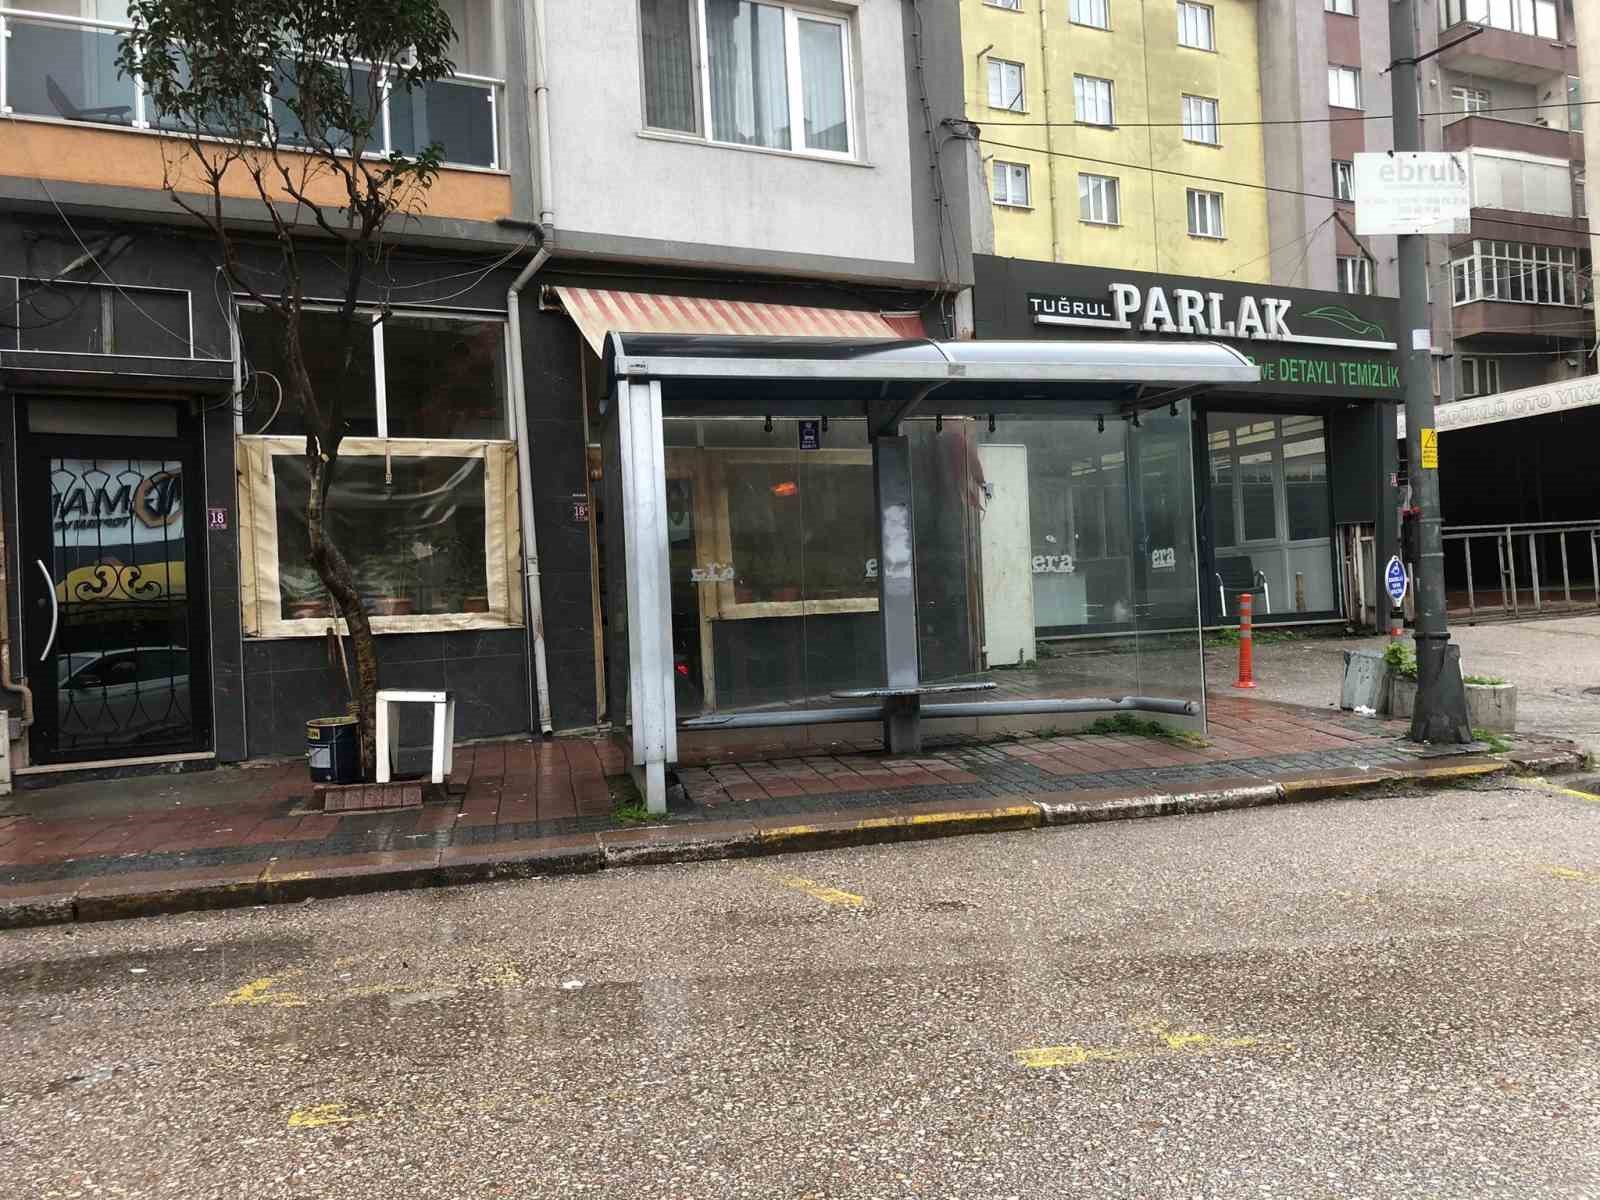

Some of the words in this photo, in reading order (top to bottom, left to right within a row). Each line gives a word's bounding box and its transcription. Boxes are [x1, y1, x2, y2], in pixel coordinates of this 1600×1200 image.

[1030, 297, 1111, 317] TUĞRUL
[1108, 283, 1292, 341] PARLAK
[1263, 361, 1276, 381] VE
[1279, 358, 1337, 384] DETAYLI
[1340, 359, 1400, 387] TEMİZLİK
[1512, 391, 1552, 412] OTO
[211, 512, 224, 524] 18
[1032, 553, 1075, 573] era
[1152, 547, 1176, 568] era
